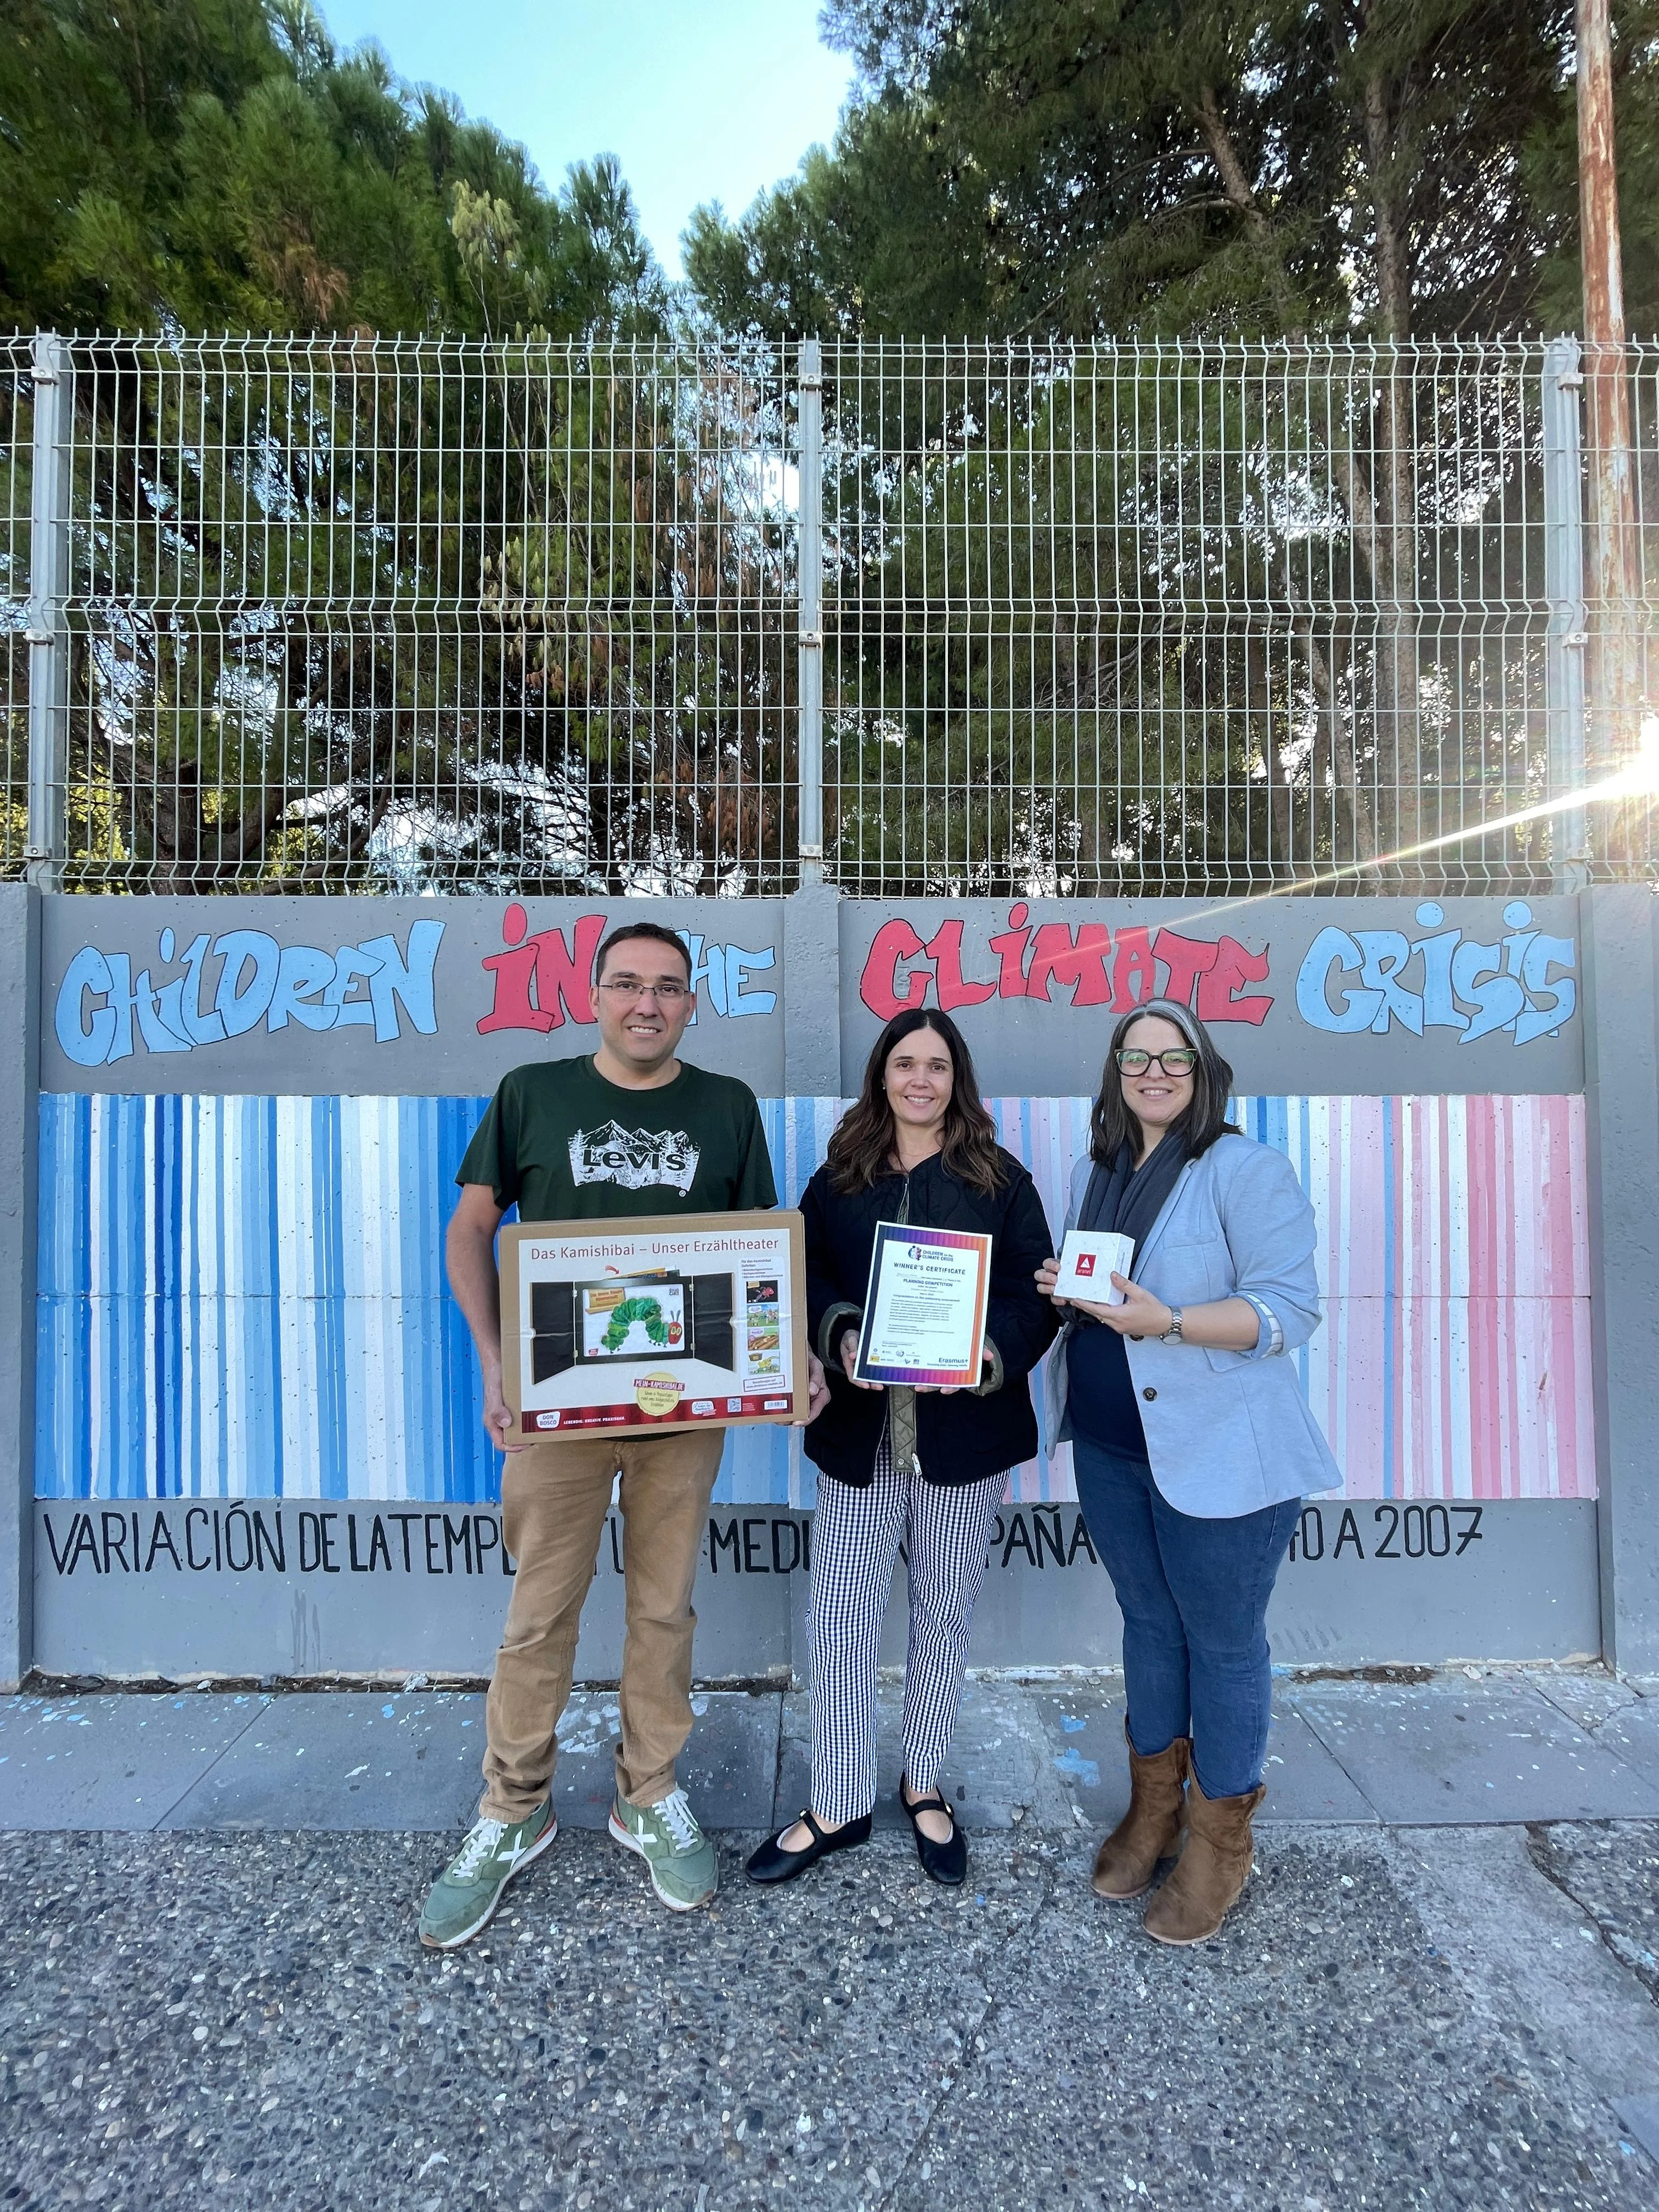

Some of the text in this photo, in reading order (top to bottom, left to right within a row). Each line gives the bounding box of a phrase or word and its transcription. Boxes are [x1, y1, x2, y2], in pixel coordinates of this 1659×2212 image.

[675, 929, 777, 1026] HE
[532, 1248, 556, 1260] Das
[561, 1244, 634, 1259] Kamishibai
[652, 1243, 690, 1254] Unser
[694, 1239, 778, 1252] Erzähltheater
[894, 1262, 966, 1274] WINNER'S CERTIFICATE
[43, 1500, 286, 1575] VARIACIÓN
[299, 1512, 340, 1572] DE
[1333, 1508, 1365, 1559] A
[1375, 1505, 1483, 1558] 2007
